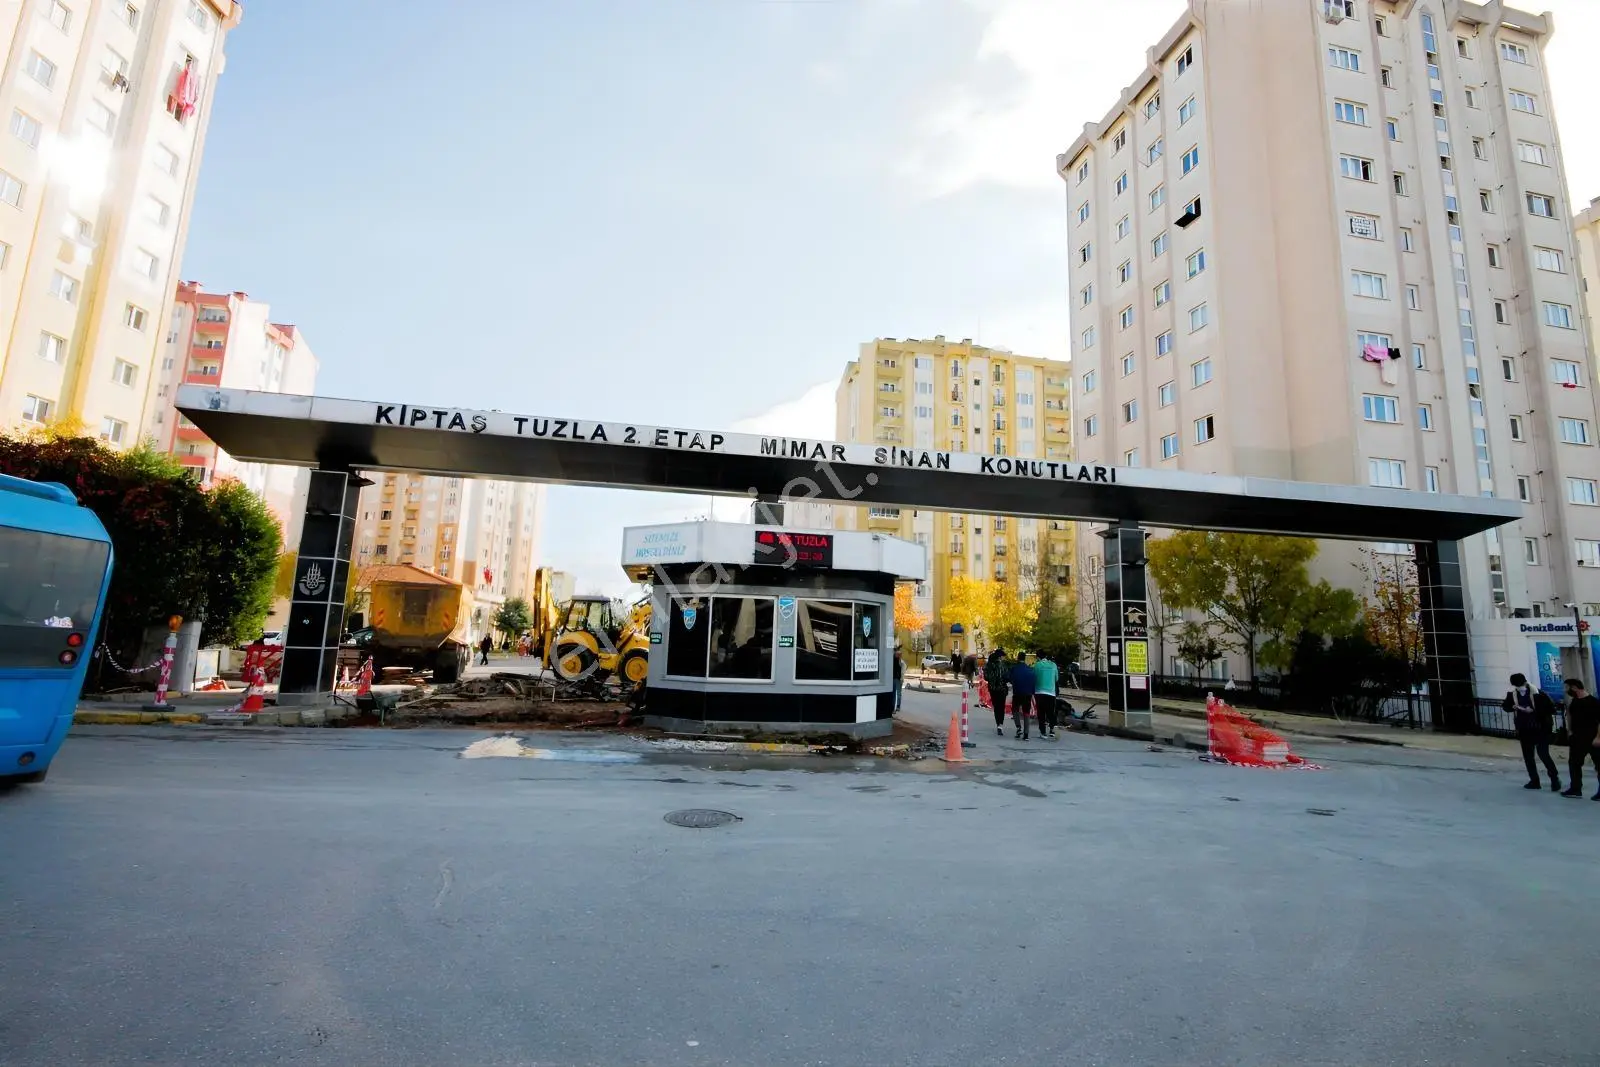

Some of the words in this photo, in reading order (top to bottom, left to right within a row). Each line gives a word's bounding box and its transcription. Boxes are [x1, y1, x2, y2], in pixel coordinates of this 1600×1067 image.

[513, 417, 608, 442] TUZLA
[624, 427, 641, 444] 2.
[654, 429, 724, 450] ETAP
[981, 457, 1116, 482] KONUTLARI
[795, 535, 828, 547] TUZLA
[1520, 623, 1574, 632] DenizBank
